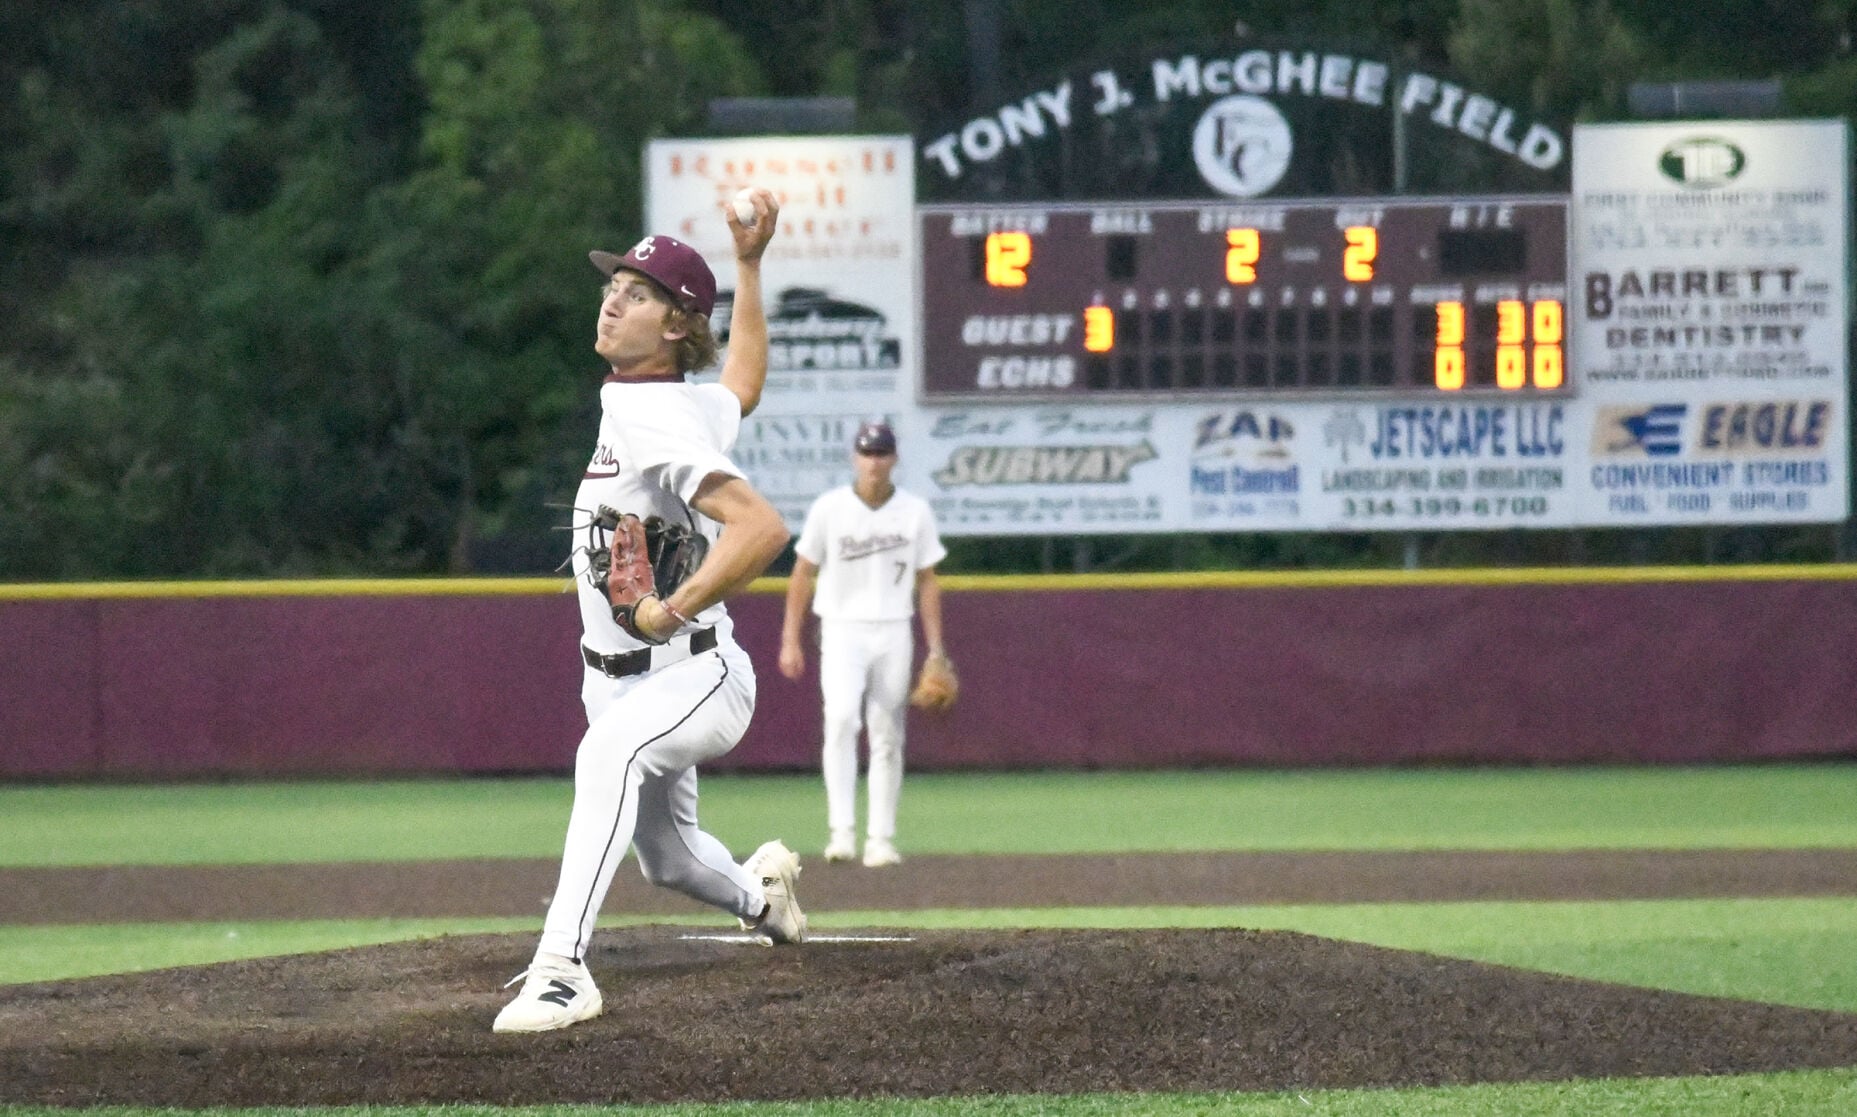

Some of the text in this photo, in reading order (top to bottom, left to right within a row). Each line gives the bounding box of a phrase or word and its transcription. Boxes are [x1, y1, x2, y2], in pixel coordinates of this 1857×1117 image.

[924, 50, 1563, 178] TONY J. McGHEE FIELD
[1225, 228, 1260, 284] 2
[1343, 226, 1378, 282] 2
[1585, 266, 1801, 320] BARRETT
[962, 314, 1075, 345] GUEST
[1084, 306, 1114, 352] 3
[1436, 299, 1563, 346] 3 3 0
[1606, 326, 1805, 349] DENTISTRY
[1435, 345, 1563, 390] 0 0 0
[1370, 407, 1564, 460] JETSCAPE LLC
[1702, 401, 1828, 449] EAGLE
[930, 438, 1159, 489] SUBWAY
[1591, 462, 1735, 490] CONVENIENT
[893, 561, 908, 586] 7
